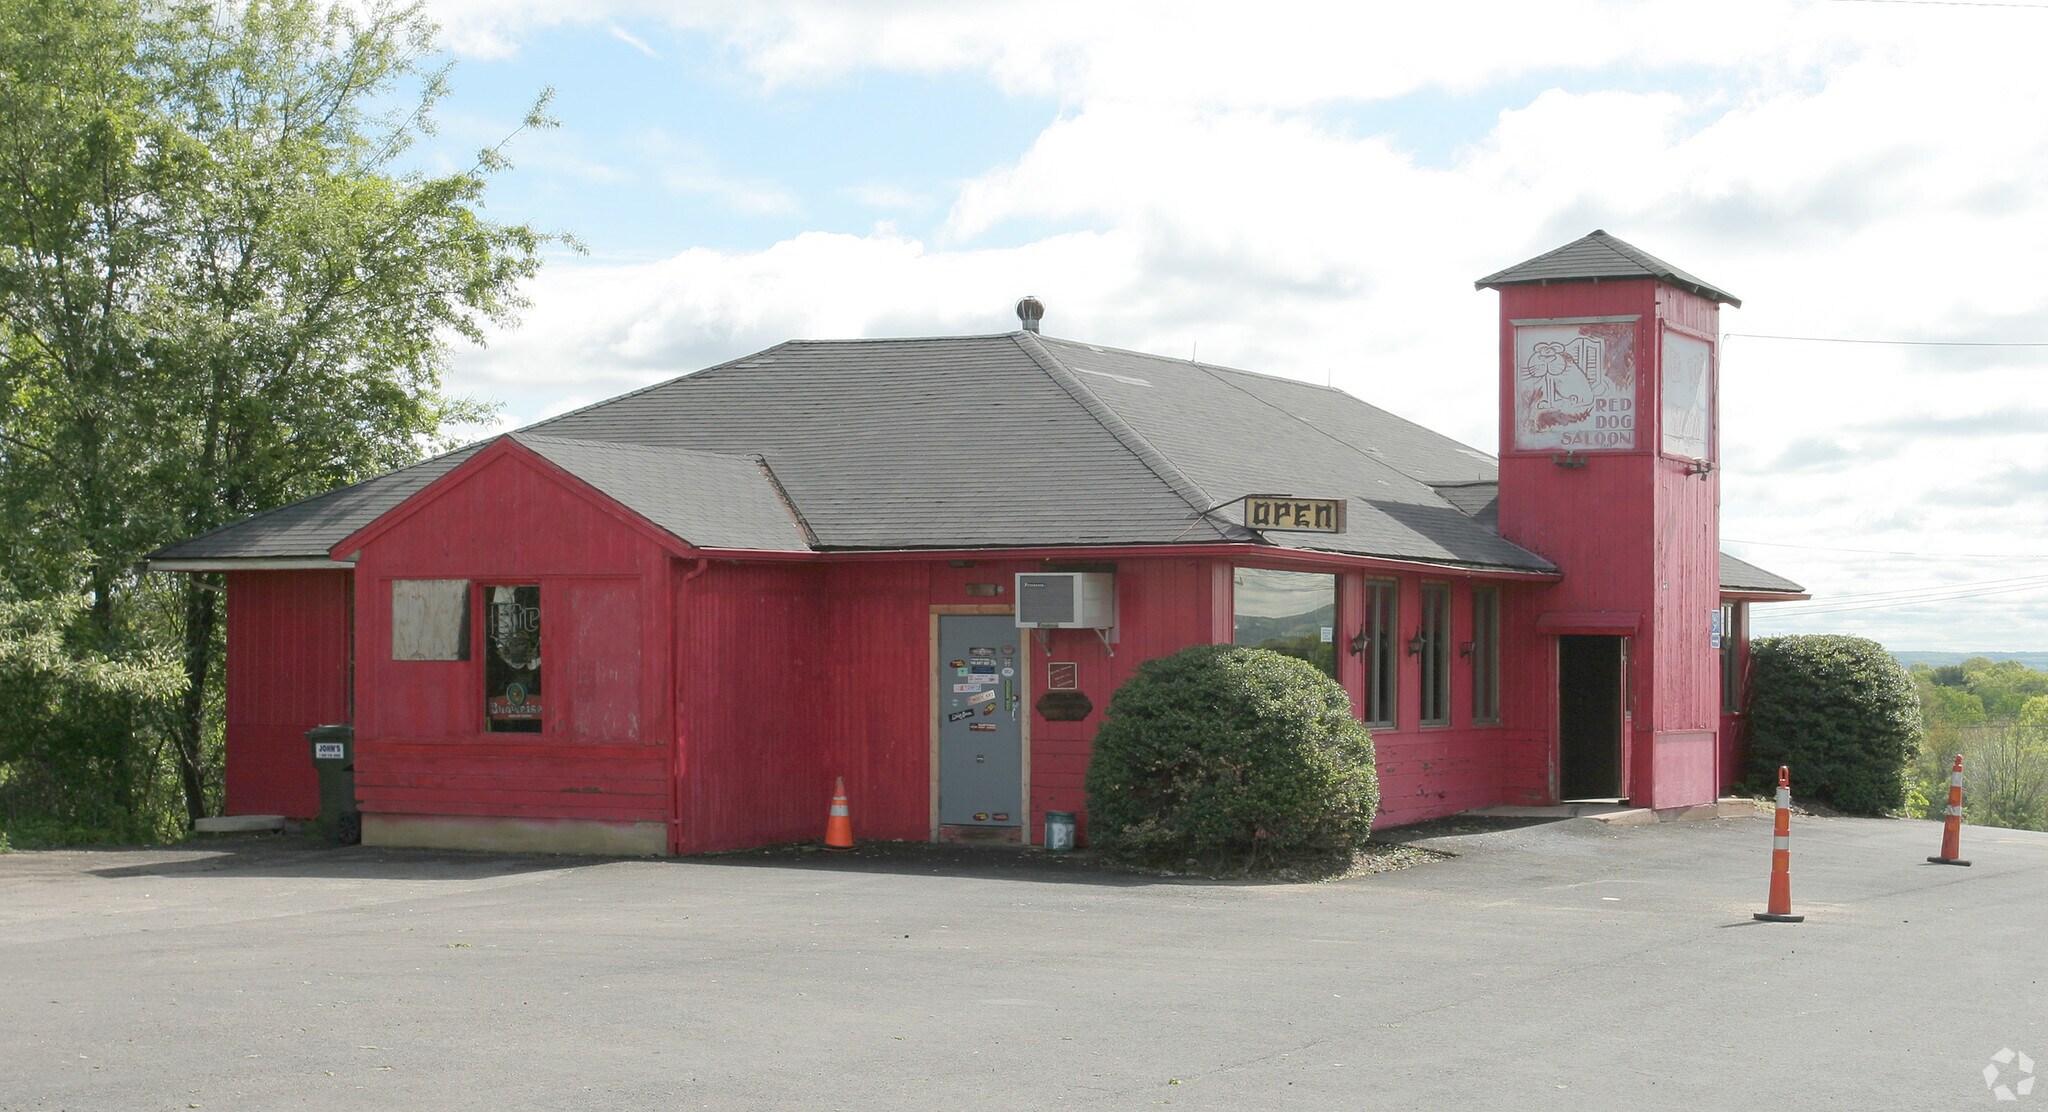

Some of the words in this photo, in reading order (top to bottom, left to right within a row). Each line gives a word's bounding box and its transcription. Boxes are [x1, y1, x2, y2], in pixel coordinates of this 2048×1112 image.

[1595, 398, 1632, 412] RED
[1595, 414, 1632, 429] DOG
[1561, 431, 1632, 446] SALOON
[1252, 501, 1332, 529] OPEN
[491, 702, 542, 714] Budweise
[319, 744, 341, 752] JOHN'S
